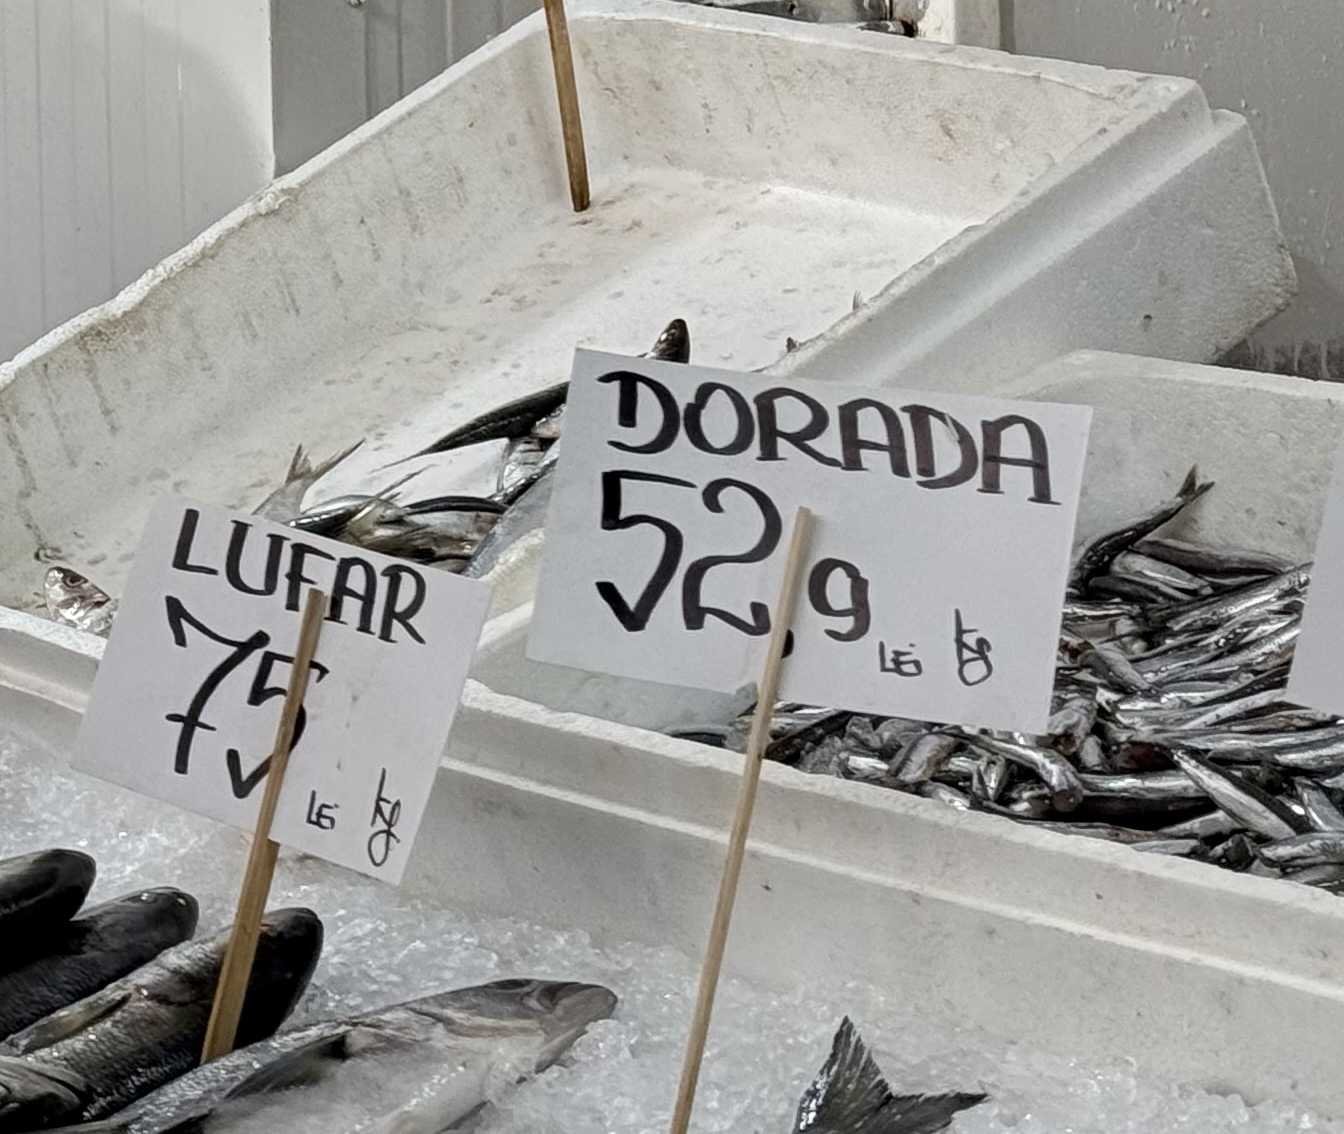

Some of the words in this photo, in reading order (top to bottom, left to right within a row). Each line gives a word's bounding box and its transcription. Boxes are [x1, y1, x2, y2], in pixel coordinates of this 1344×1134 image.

[596, 370, 1062, 505] DORADA
[171, 508, 427, 645] LUFAR
[165, 594, 330, 799] 75
